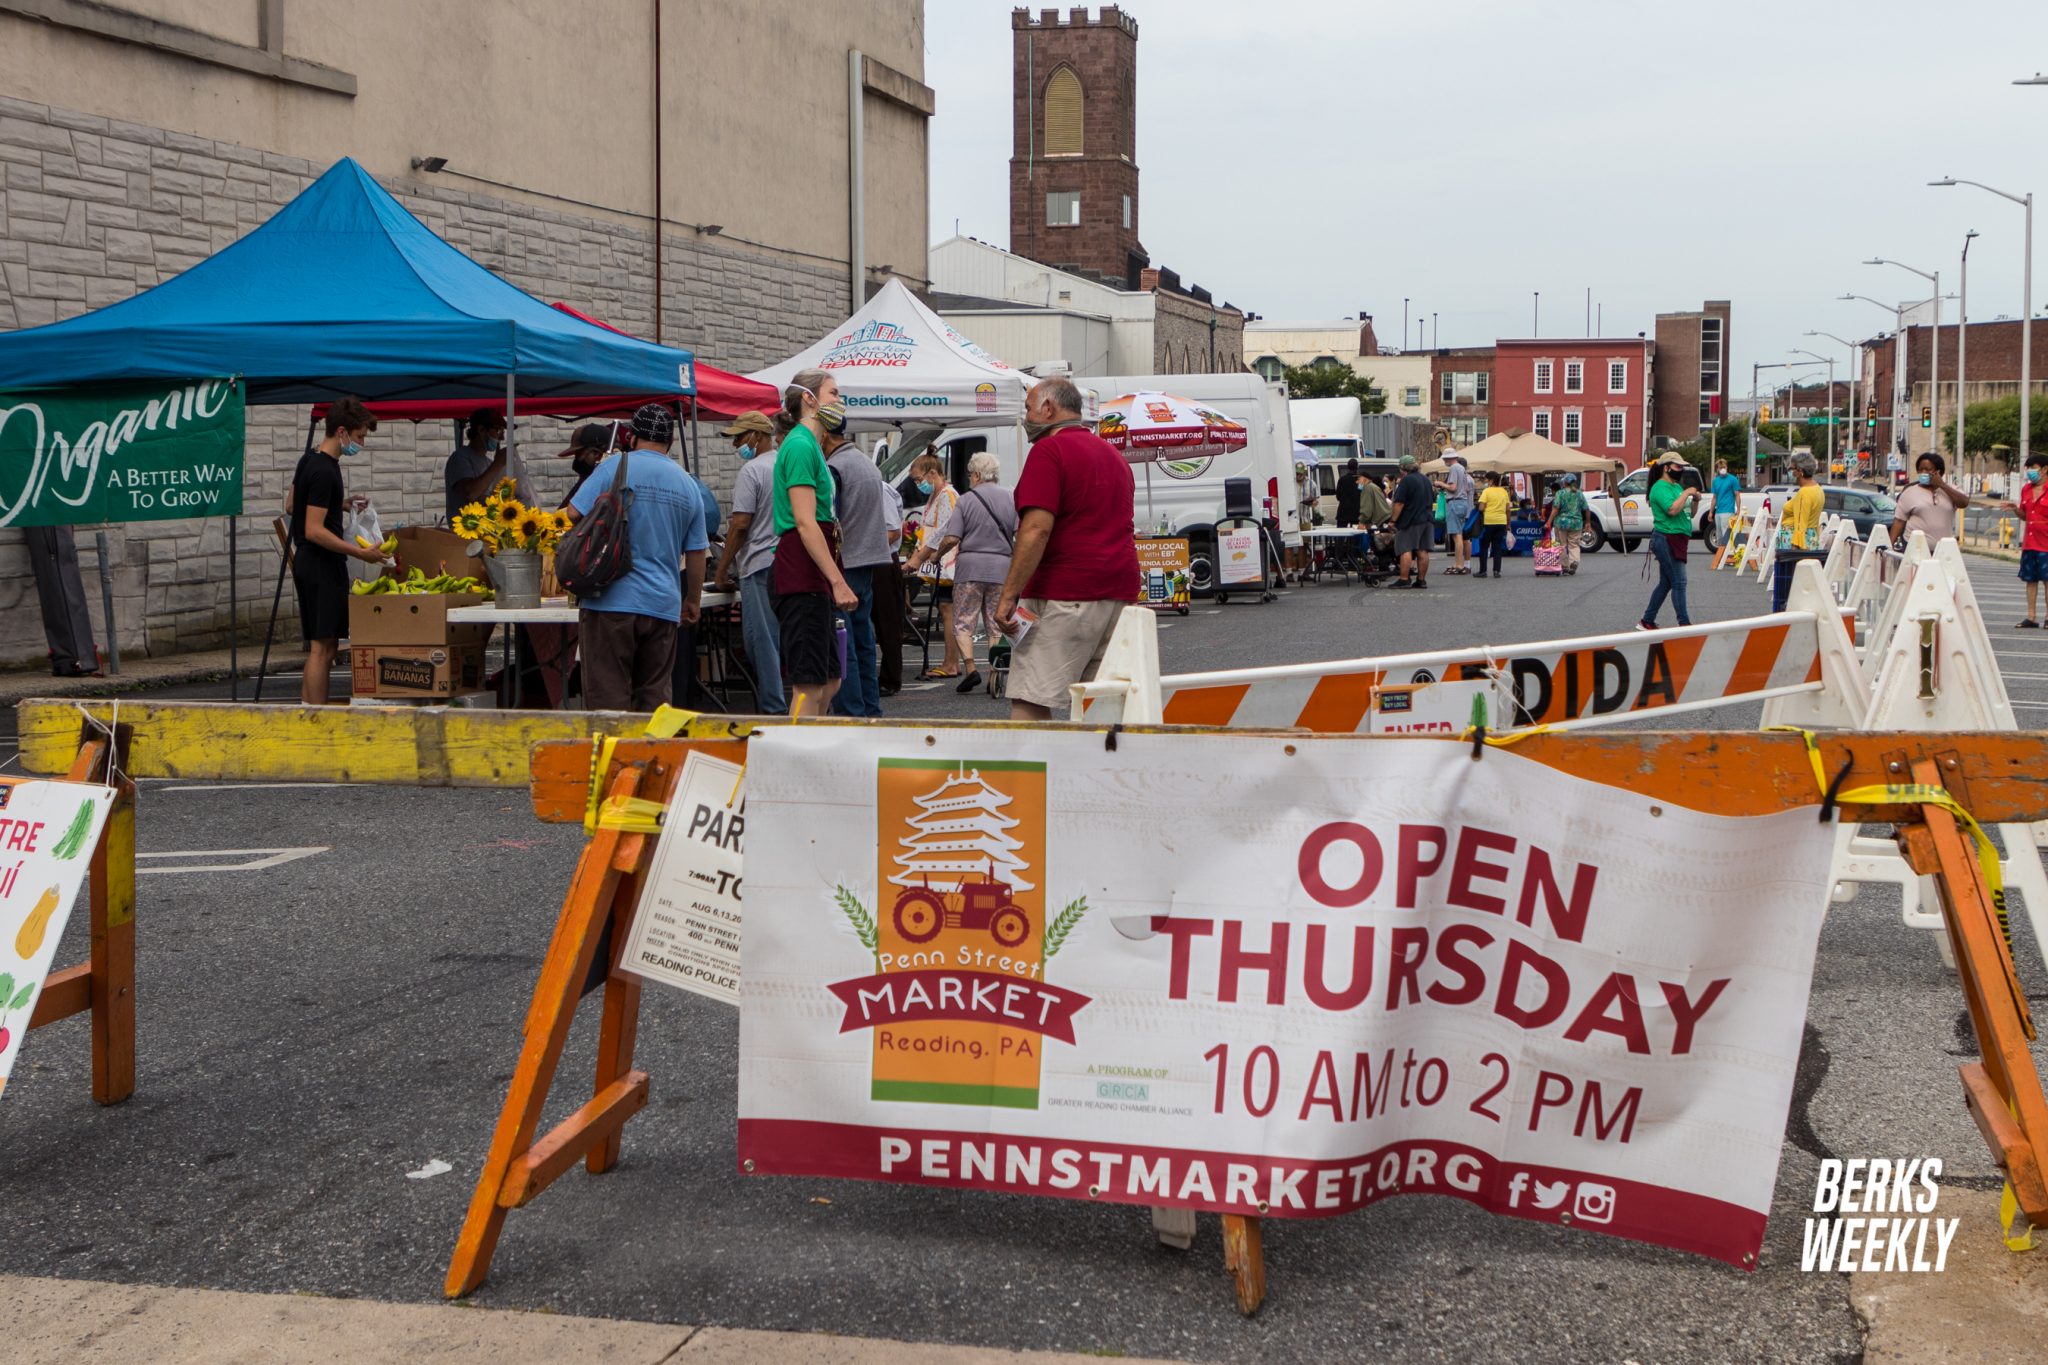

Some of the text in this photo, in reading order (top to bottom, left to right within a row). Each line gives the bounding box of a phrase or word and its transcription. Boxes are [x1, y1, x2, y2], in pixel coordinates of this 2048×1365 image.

[818, 358, 908, 369] READING
[820, 351, 912, 364] DOWNTOWN
[1132, 432, 1203, 441] PENNSTMARKET.ORG
[107, 463, 235, 488] A BETTER WAY
[129, 488, 220, 509] TO GROW
[1516, 527, 1541, 535] GRIFOLS
[1135, 542, 1185, 551] SHOP LOCAL
[384, 670, 431, 685] BANANAS
[1298, 821, 1599, 943] OPEN
[691, 902, 711, 913] AUG
[686, 918, 707, 931] PENN
[708, 925, 738, 940] STREET
[688, 930, 703, 941] 400
[714, 938, 739, 952] PENN
[641, 951, 737, 990] READING POLICE
[879, 945, 1041, 978] Penn Street
[1151, 915, 1732, 1056] THURSDAY
[858, 977, 1062, 1026] MARKET
[1000, 1037, 1034, 1058] PA
[1087, 1064, 1169, 1079] A PROGRAM OF
[1099, 1084, 1147, 1099] GRCA
[1203, 1042, 1644, 1144] 10 AM to 2 PM
[1048, 1098, 1194, 1116] GREATER READING CHAMBER ALLIANCE
[879, 1135, 1484, 1209] PENNSTMARKET.ORG
